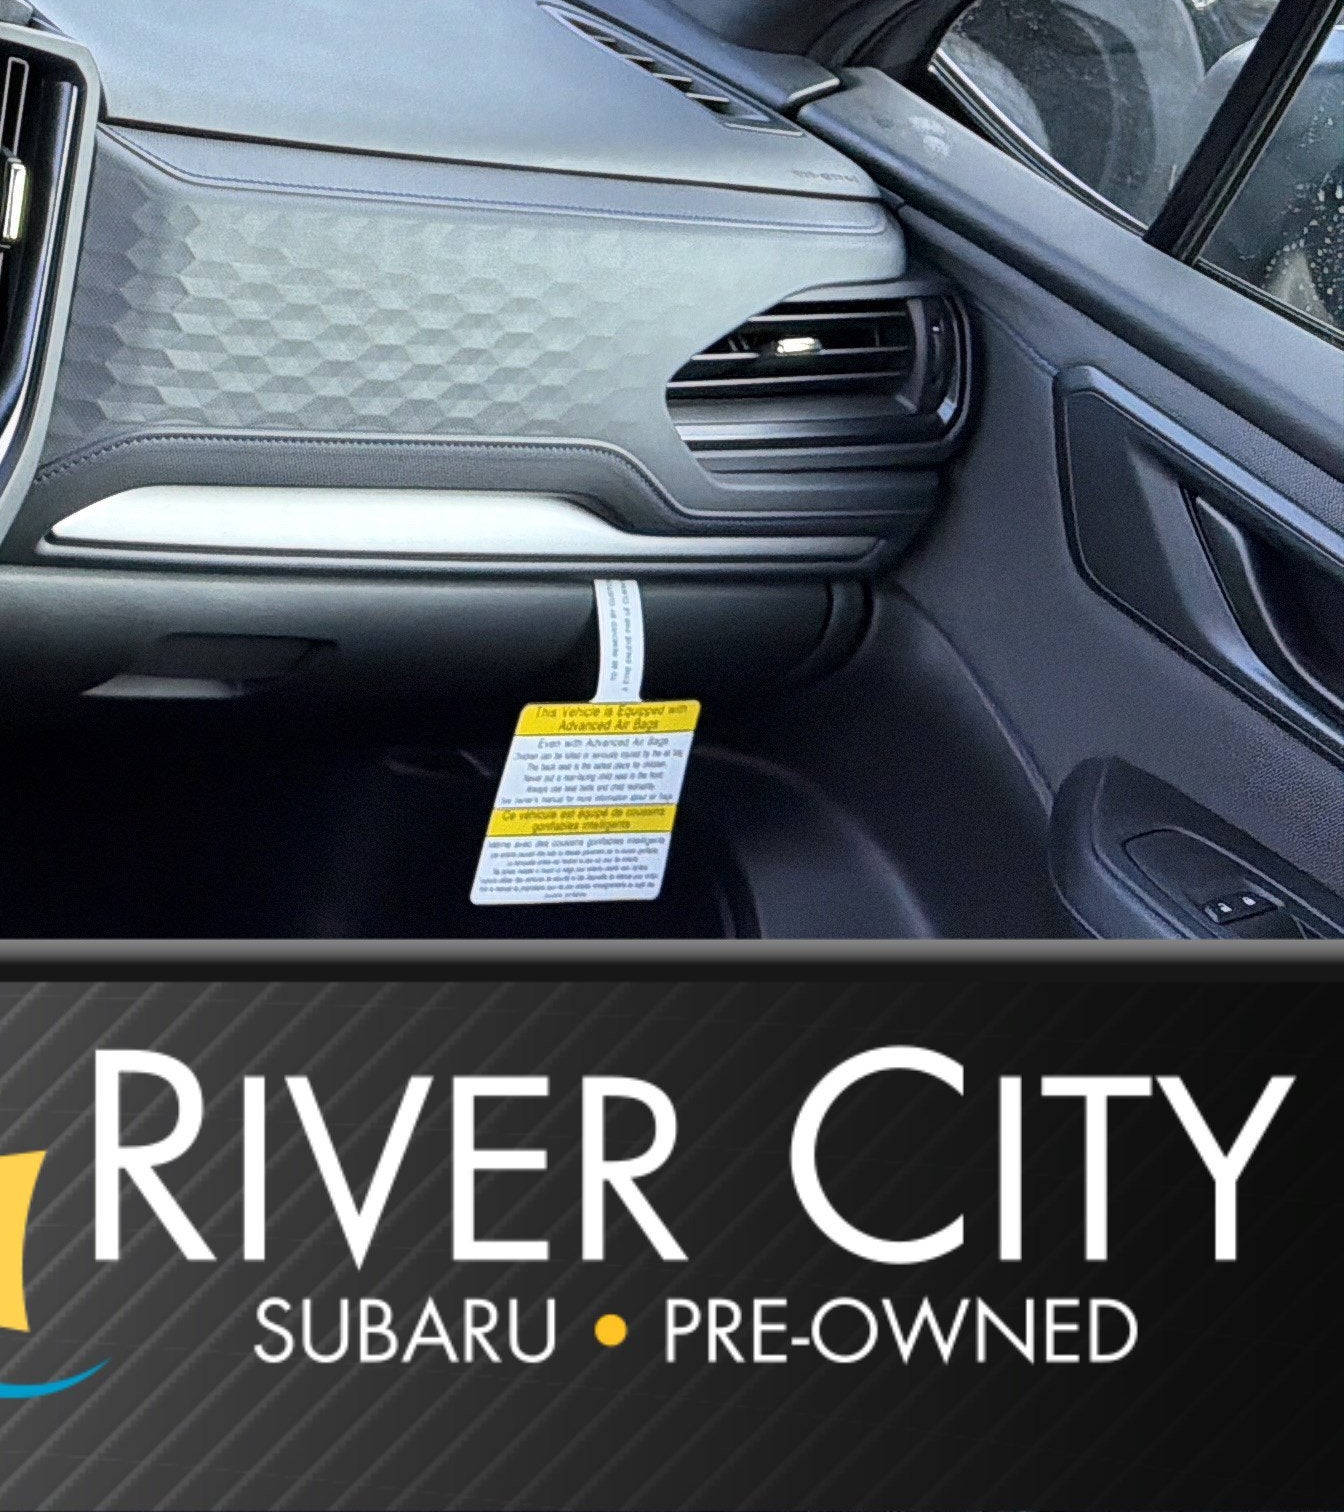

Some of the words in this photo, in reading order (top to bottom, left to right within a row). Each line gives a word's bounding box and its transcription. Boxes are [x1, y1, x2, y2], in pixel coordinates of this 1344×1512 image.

[536, 706, 557, 718] This
[563, 705, 601, 718] Vehicle
[617, 704, 666, 718] Equipped
[559, 719, 612, 732] Advanced
[614, 719, 630, 730] Air
[633, 719, 659, 732] Bags
